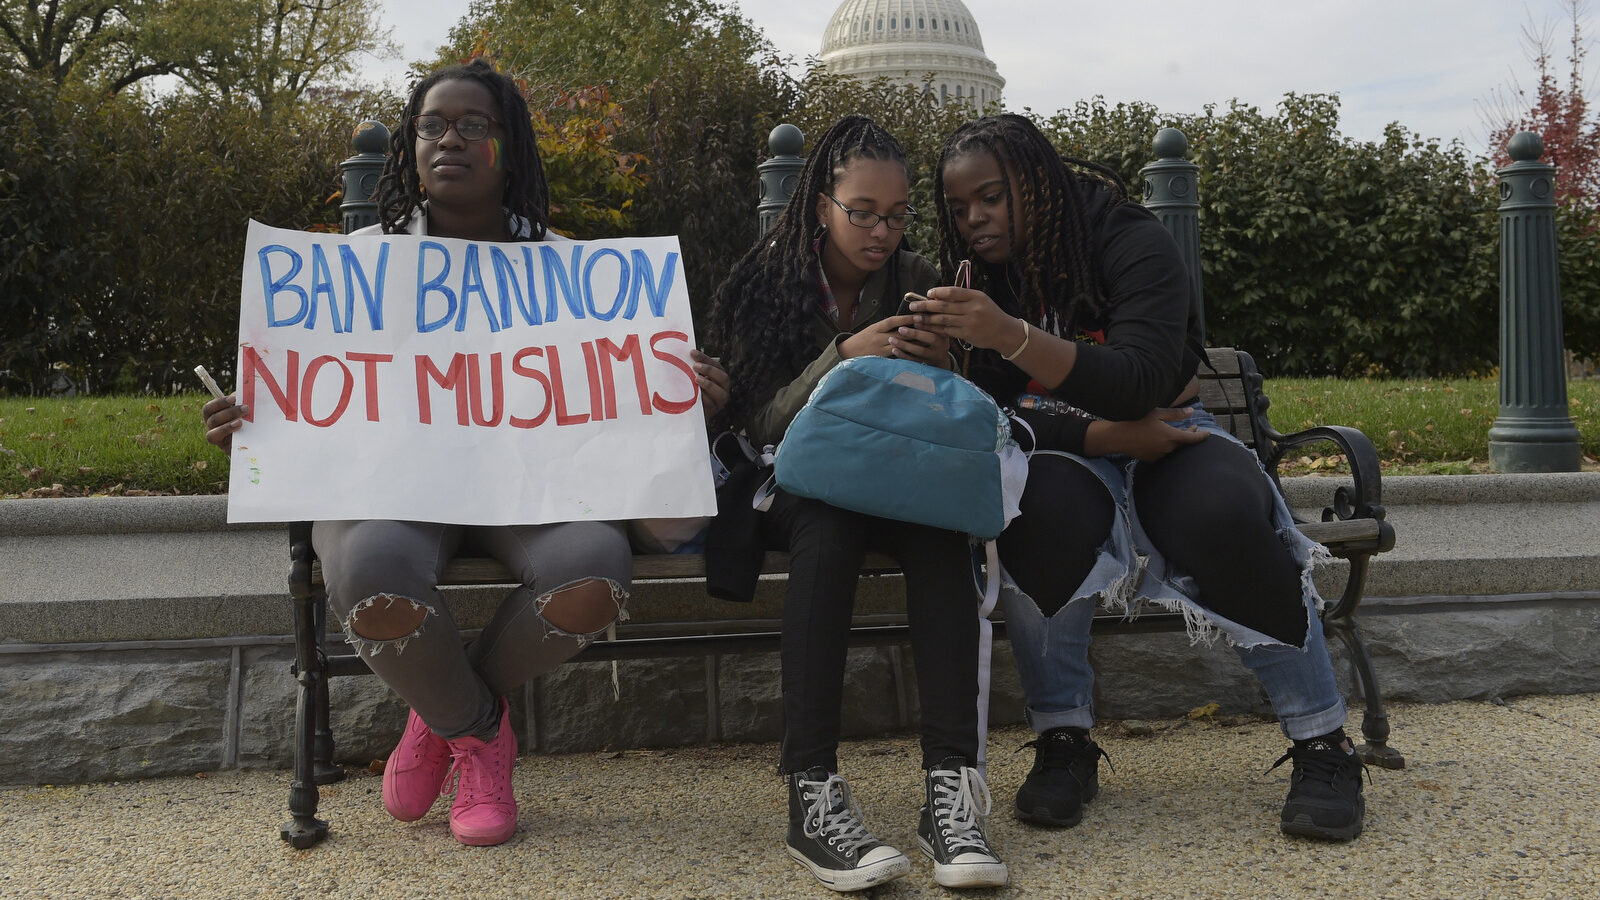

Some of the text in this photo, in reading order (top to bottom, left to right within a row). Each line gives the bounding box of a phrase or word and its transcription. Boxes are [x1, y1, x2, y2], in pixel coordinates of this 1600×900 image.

[258, 241, 678, 334] BAN BANNON
[242, 331, 701, 429] NOT MUSLIMS
